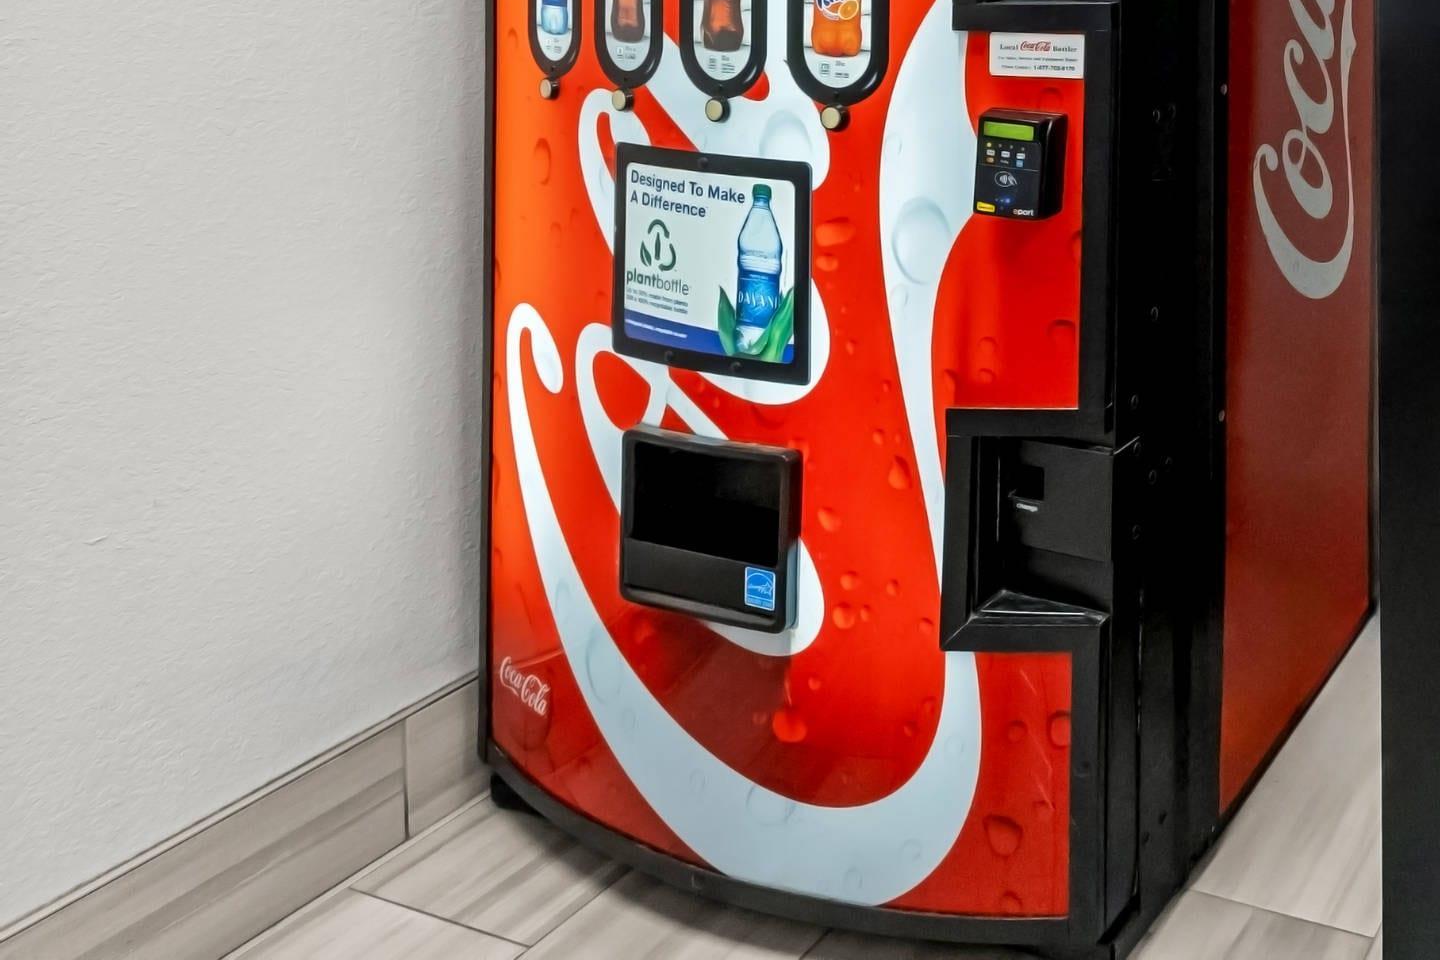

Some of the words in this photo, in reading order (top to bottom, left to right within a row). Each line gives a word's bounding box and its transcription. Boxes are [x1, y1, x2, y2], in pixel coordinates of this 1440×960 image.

[631, 169, 685, 194] Designed
[689, 182, 704, 197] To
[708, 184, 745, 204] Make
[630, 190, 639, 203] A
[642, 191, 706, 218] Difference
[626, 268, 690, 296] plantbottle
